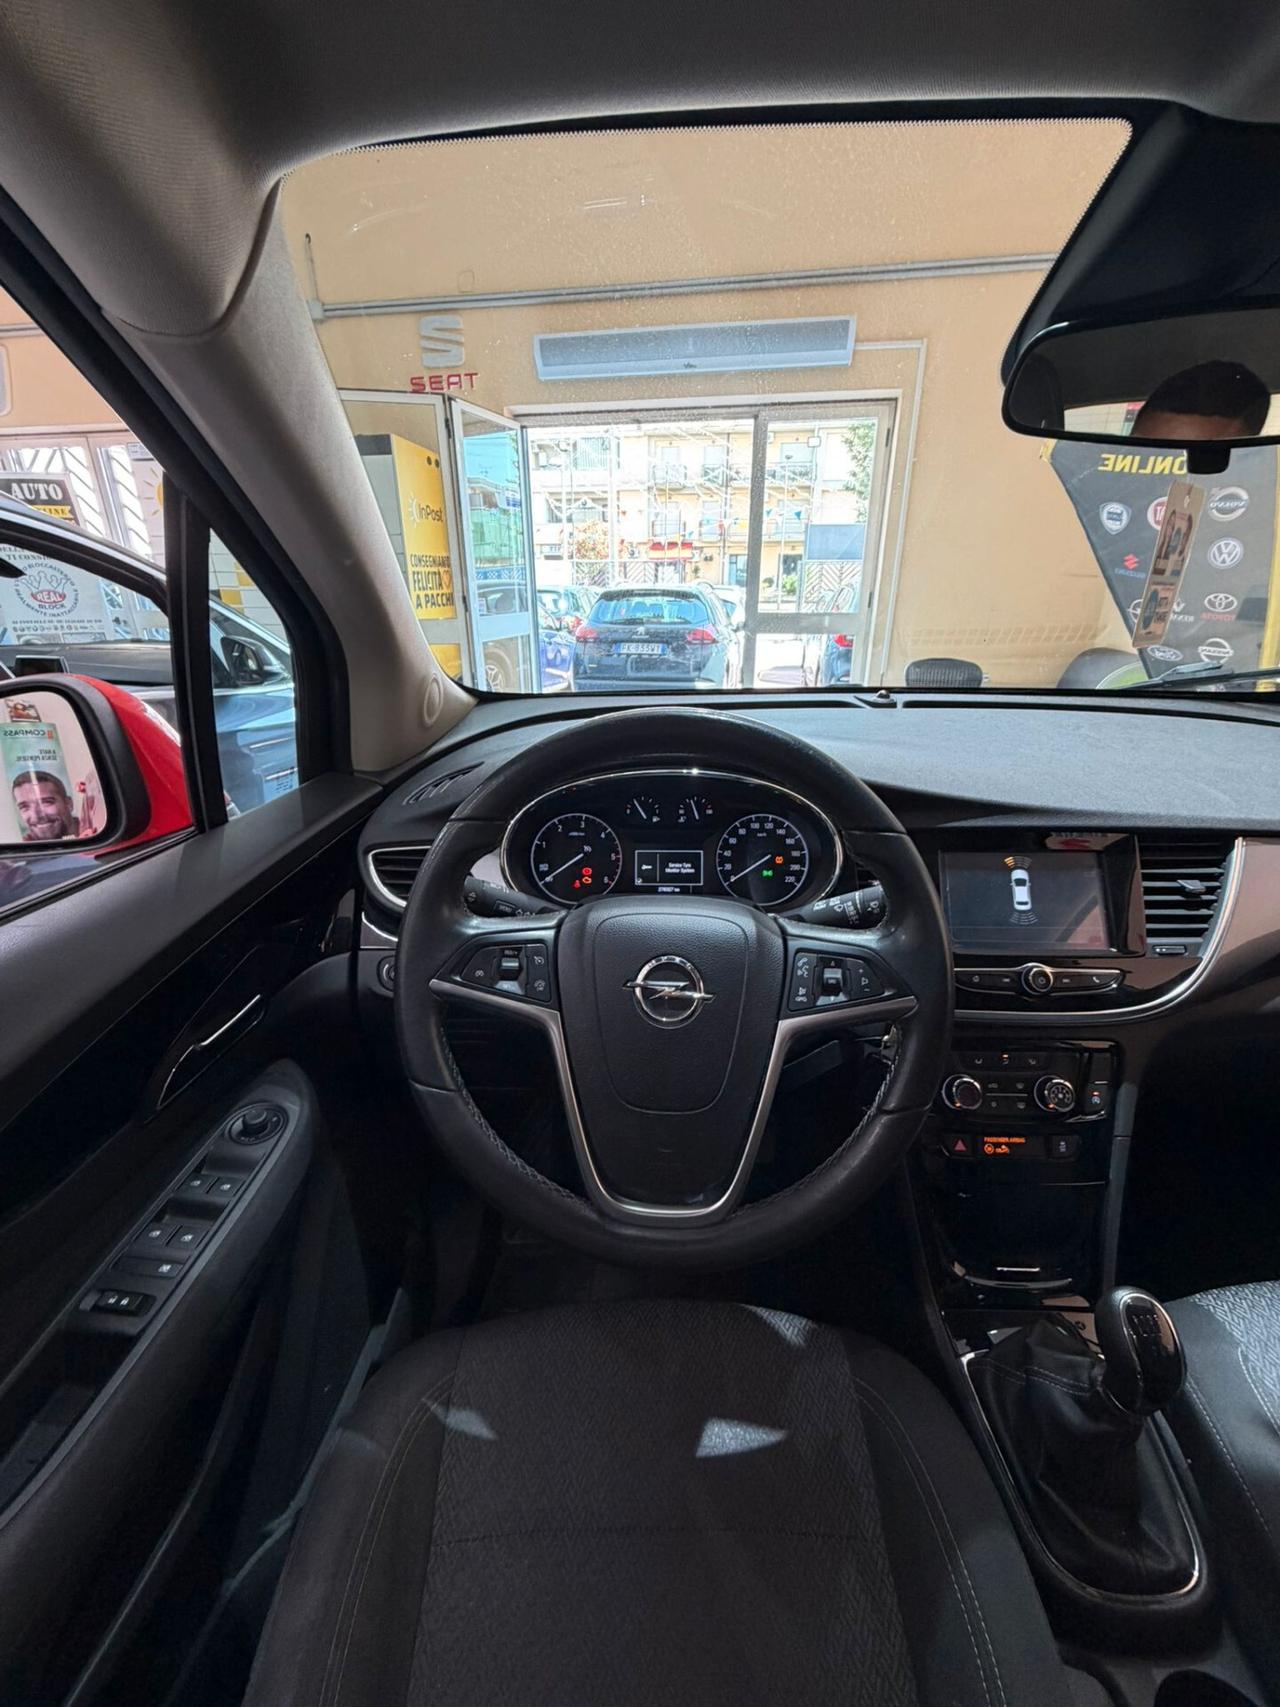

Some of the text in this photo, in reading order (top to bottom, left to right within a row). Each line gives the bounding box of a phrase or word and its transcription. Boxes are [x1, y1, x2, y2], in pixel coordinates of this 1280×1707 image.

[410, 372, 478, 392] SEAT
[11, 483, 63, 500] AUTO
[418, 503, 444, 522] InPost
[36, 592, 63, 602] REAL
[416, 594, 422, 609] A
